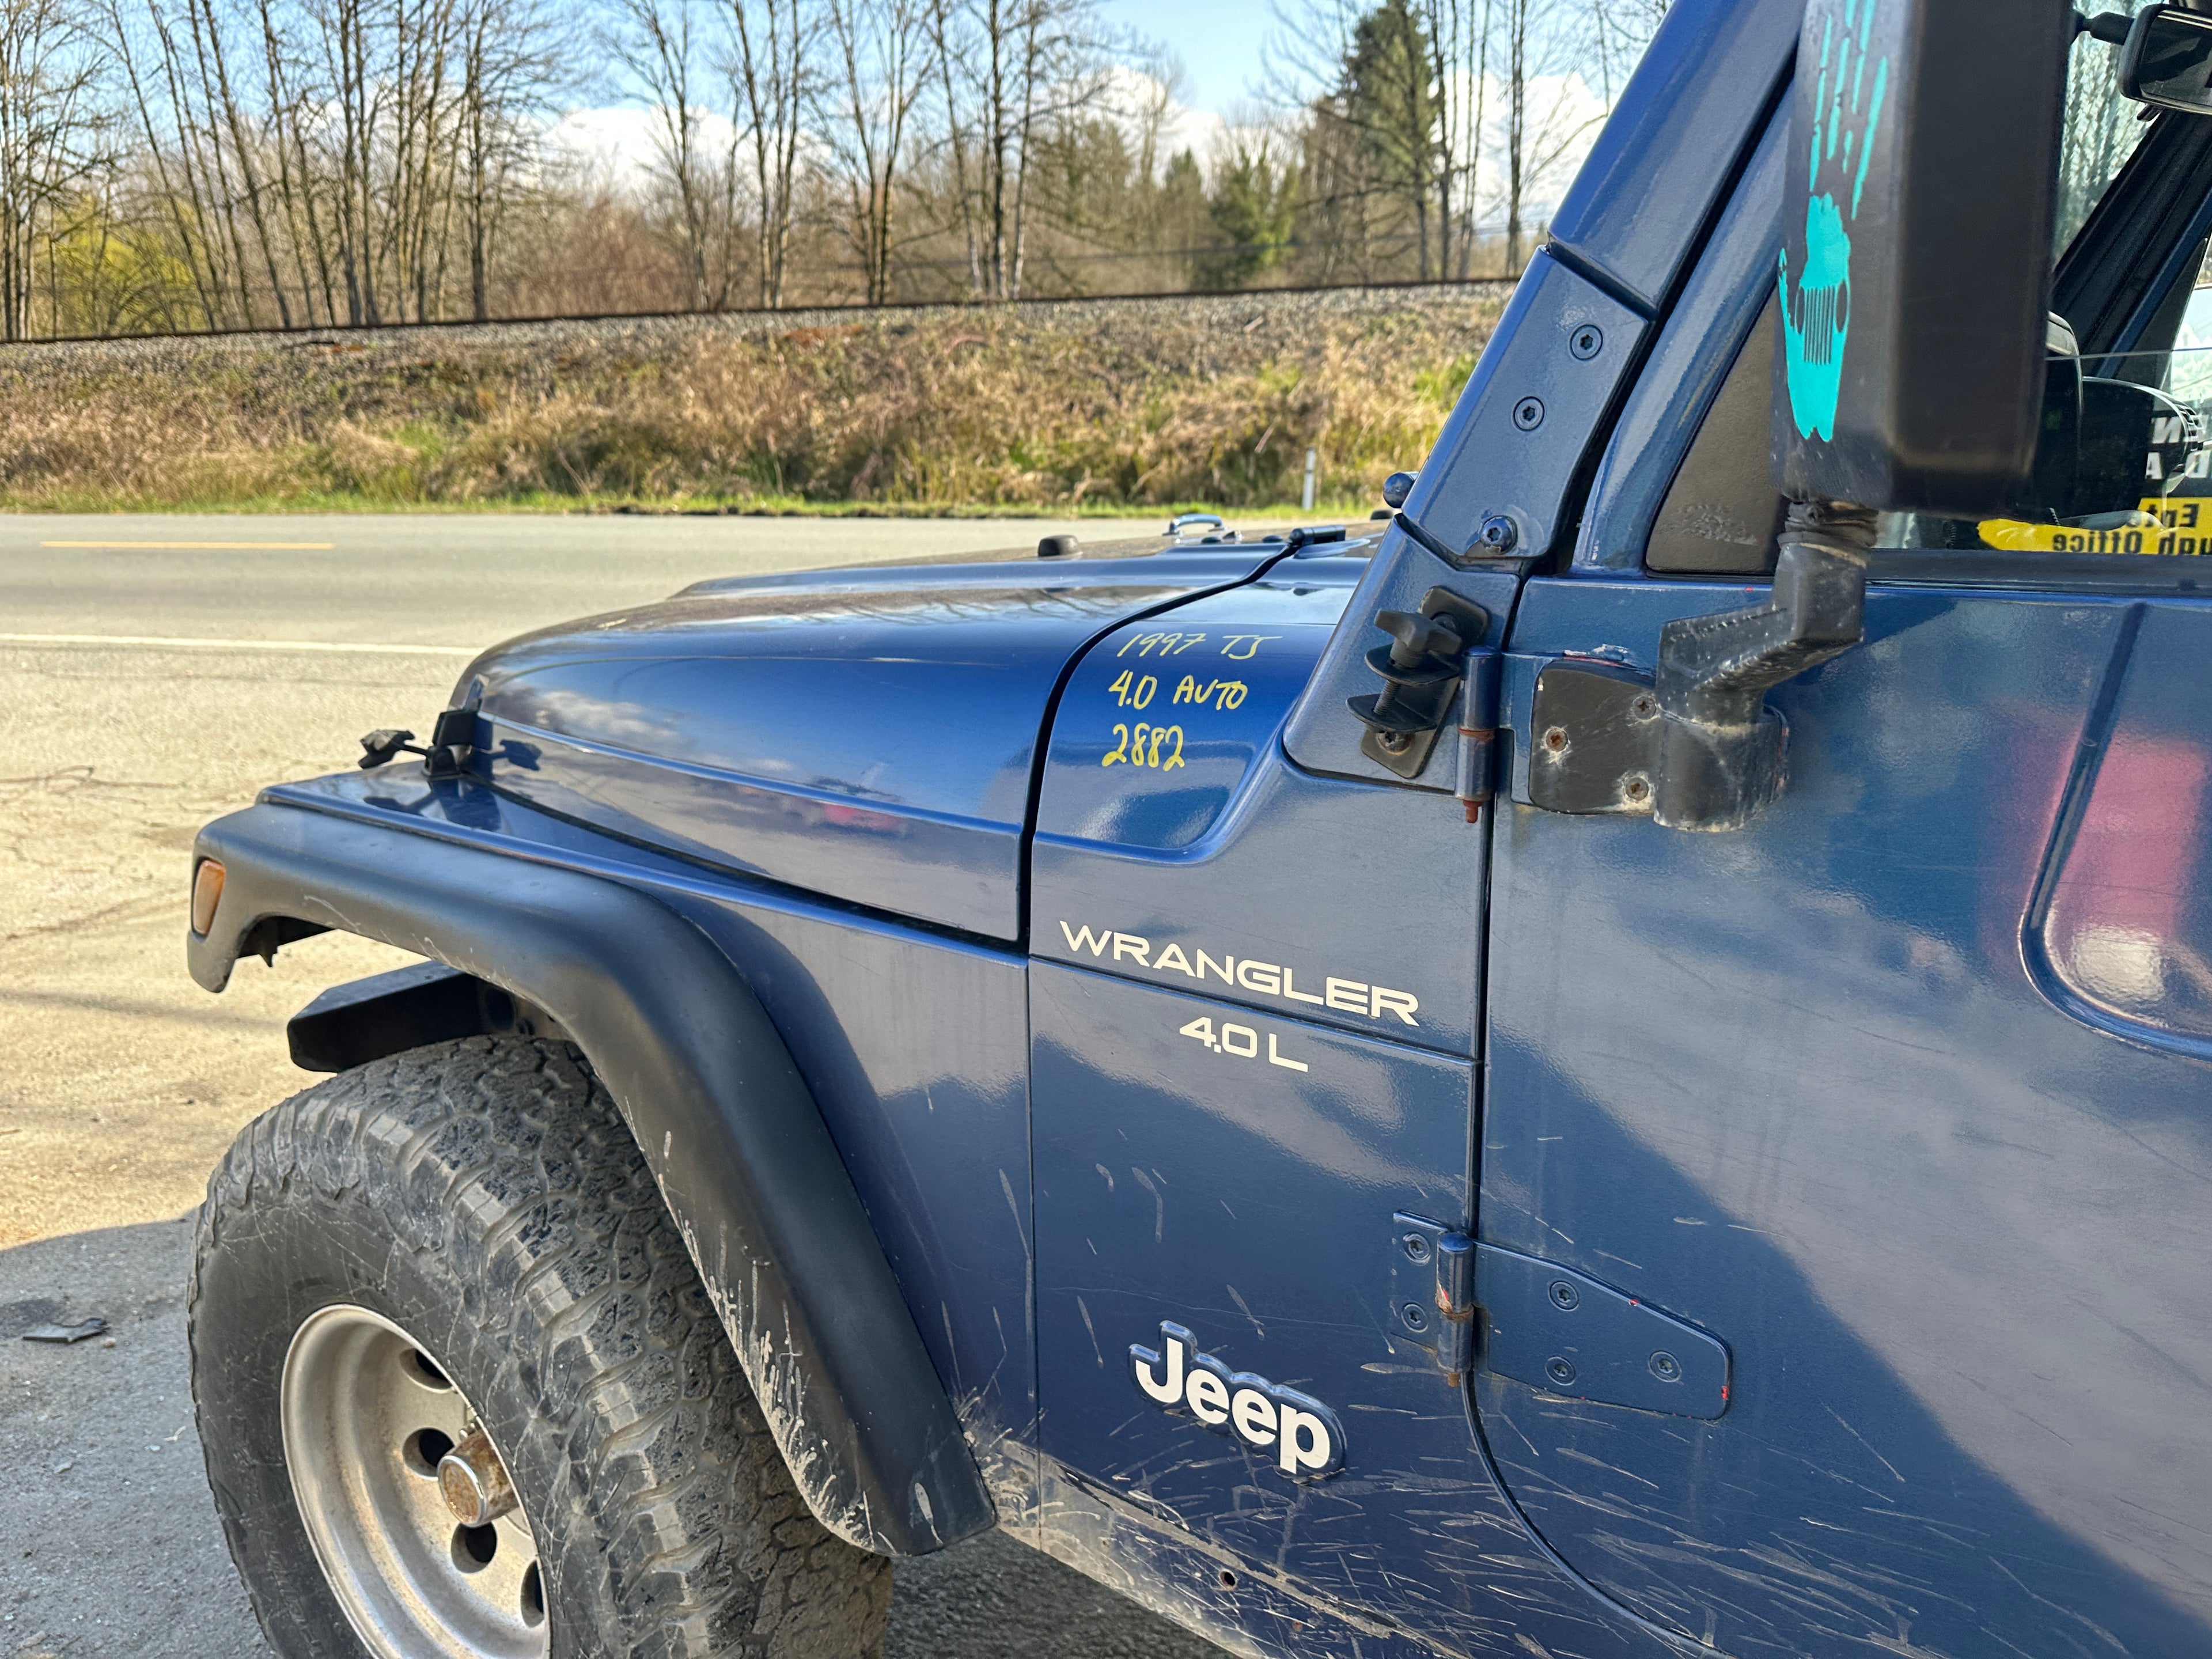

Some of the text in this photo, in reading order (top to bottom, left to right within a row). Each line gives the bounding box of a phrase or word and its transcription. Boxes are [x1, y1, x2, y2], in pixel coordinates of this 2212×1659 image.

[1116, 632, 1283, 660] 1997 TJ
[1108, 669, 1249, 710] 4.0 AUTO
[1101, 722, 1185, 772] 2882
[1059, 920, 1421, 1027] WRANGLER
[1135, 1336, 1331, 1475] Jeep
